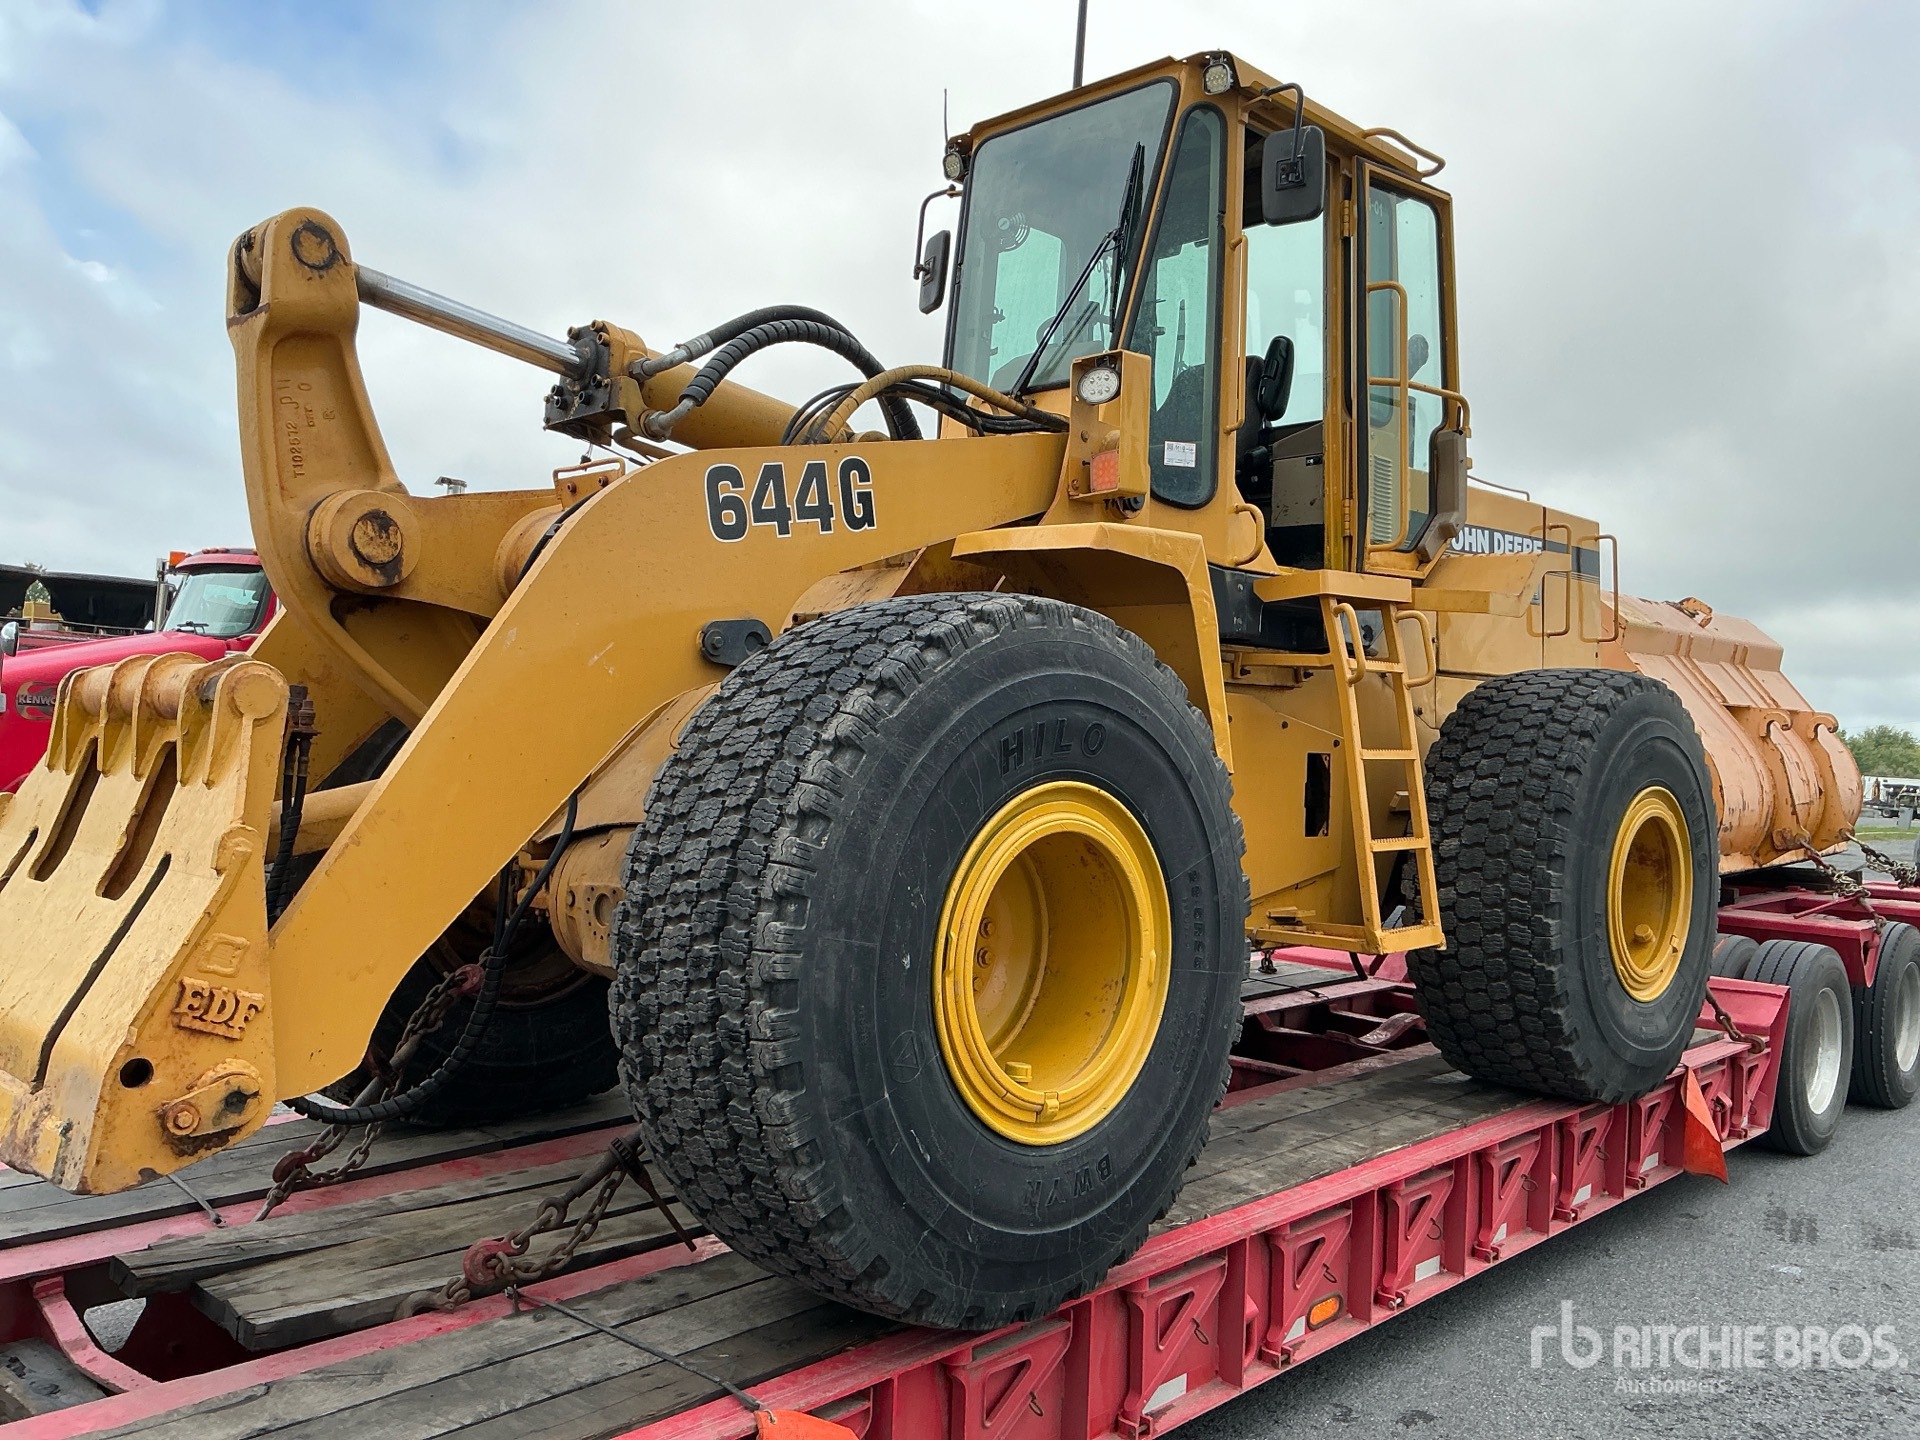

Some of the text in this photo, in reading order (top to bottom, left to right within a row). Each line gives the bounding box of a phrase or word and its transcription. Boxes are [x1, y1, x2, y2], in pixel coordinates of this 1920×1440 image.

[704, 455, 877, 543] 644G
[1451, 527, 1490, 554] OHN
[18, 694, 57, 705] KENWO
[1000, 717, 1107, 776] HILO
[172, 976, 265, 1030] EDF
